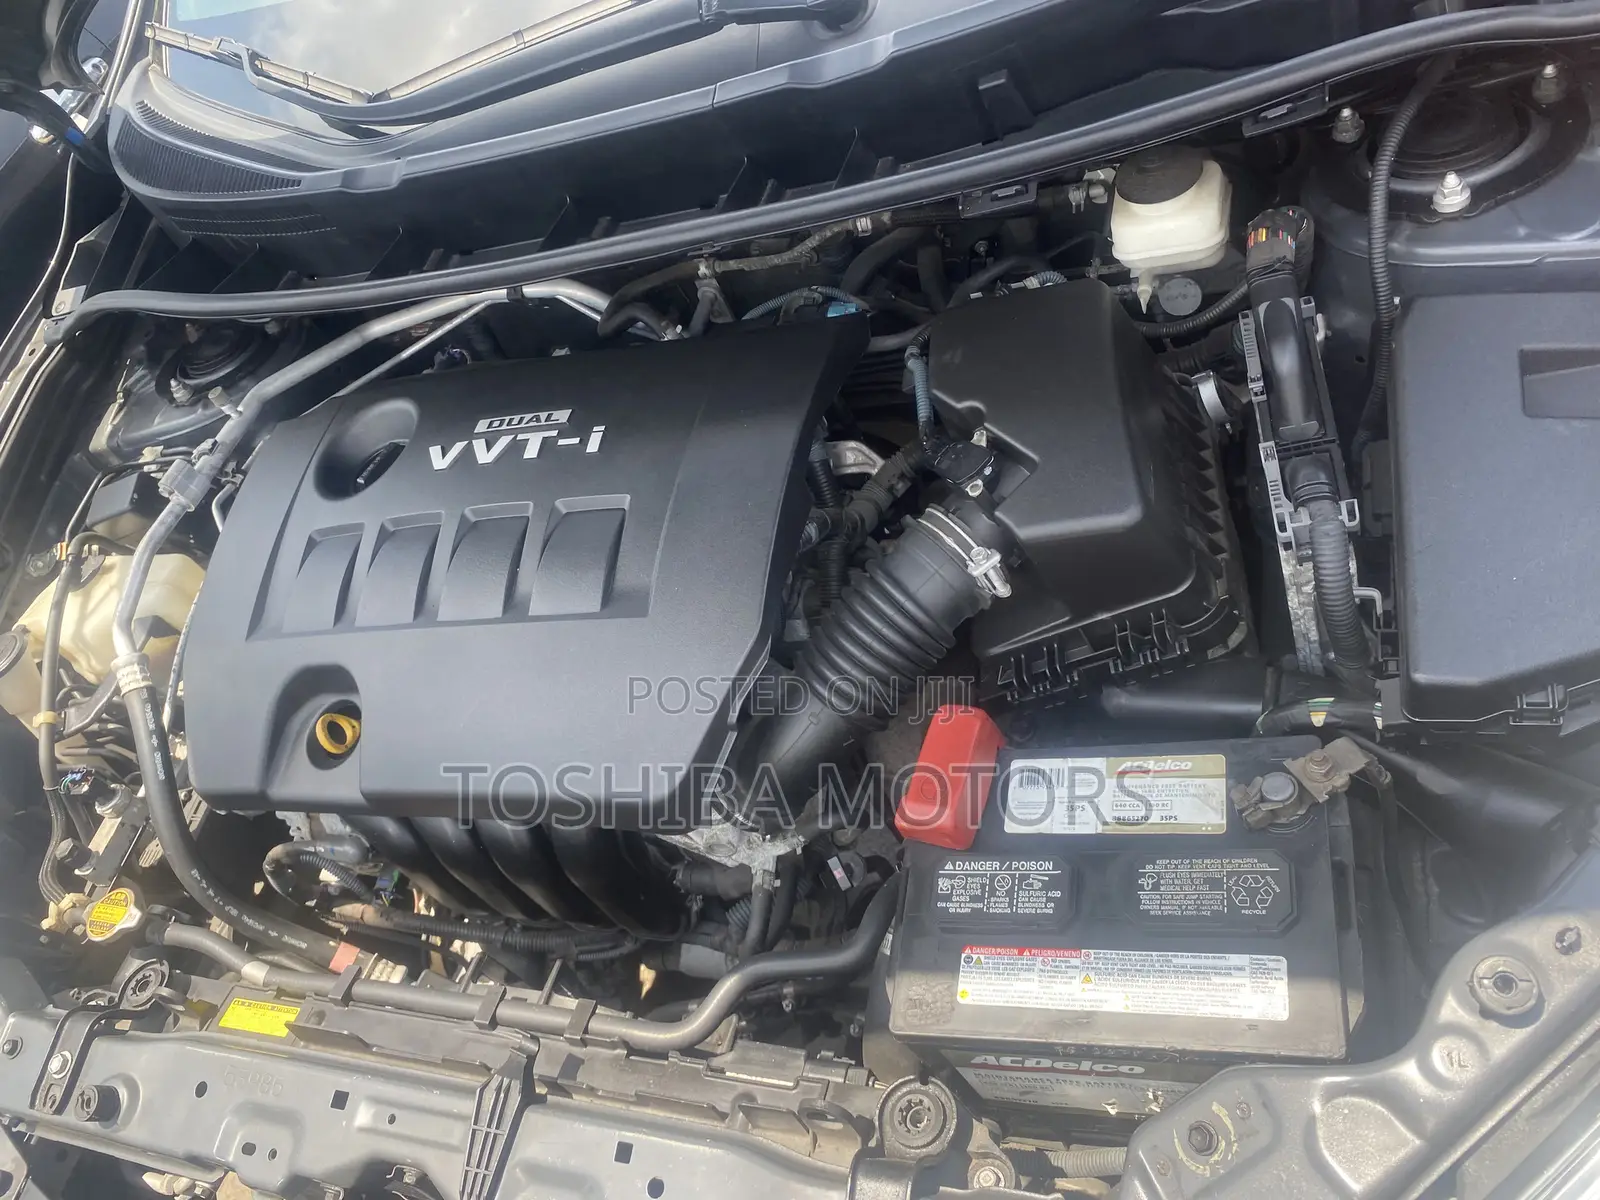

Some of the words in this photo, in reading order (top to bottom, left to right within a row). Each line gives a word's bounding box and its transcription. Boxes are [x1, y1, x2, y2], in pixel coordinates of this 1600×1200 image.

[486, 412, 560, 430] DUAL
[428, 425, 606, 471] VVT-i
[956, 861, 1000, 870] DANGER
[1012, 861, 1053, 870] POISON
[1265, 875, 1280, 892] RETURN
[972, 948, 1018, 956] DANGER/POISON
[1031, 949, 1080, 958] PELIGRO/VENENO
[970, 1054, 1146, 1074] ACDelco
